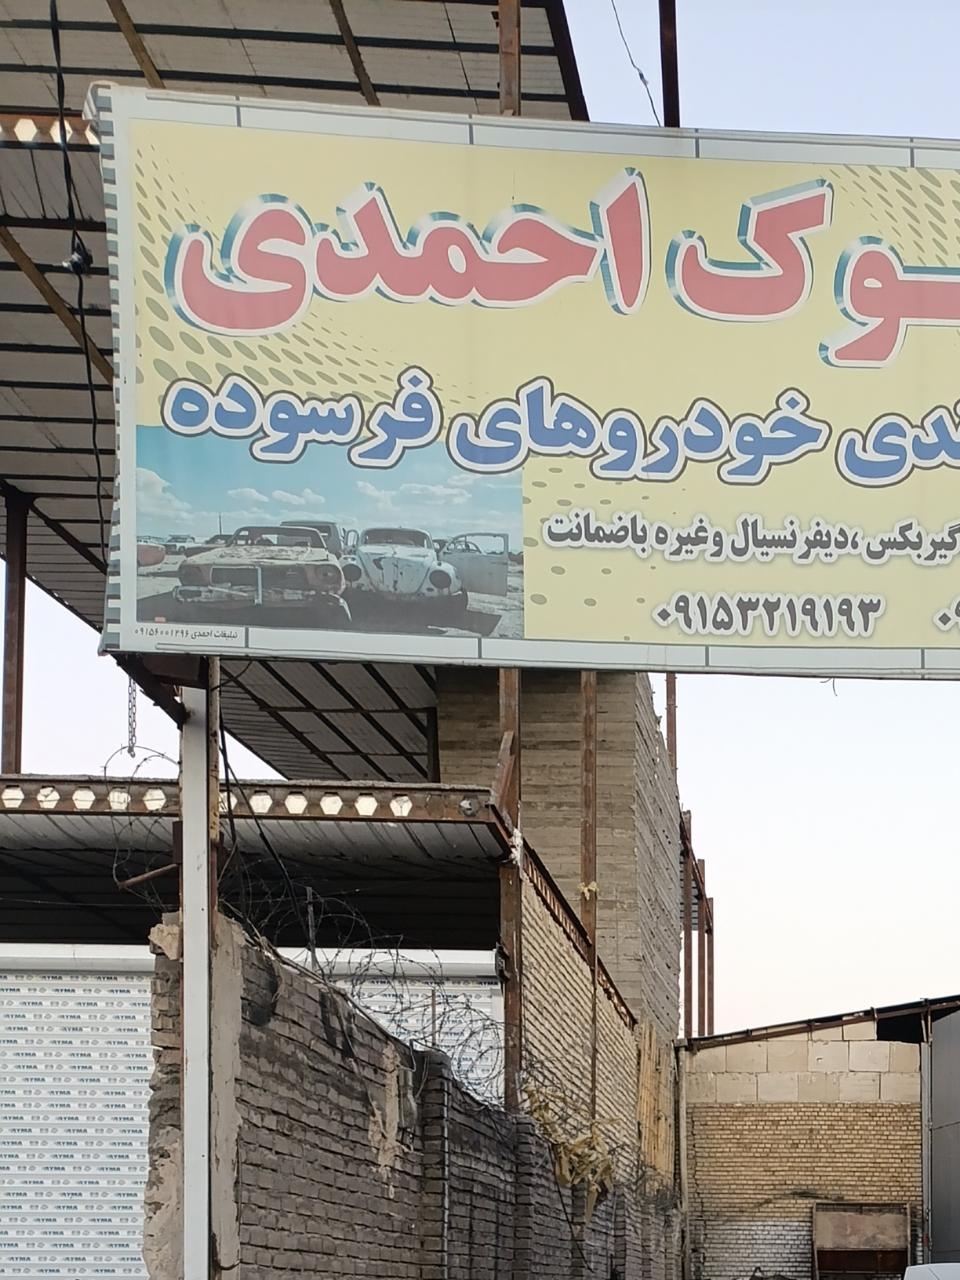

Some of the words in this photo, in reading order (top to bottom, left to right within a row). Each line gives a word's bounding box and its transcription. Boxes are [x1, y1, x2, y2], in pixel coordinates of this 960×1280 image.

[166, 168, 651, 336] احمدی
[166, 371, 439, 462] فرسوده
[452, 382, 826, 479] خودروهای
[547, 511, 648, 554] باضمانت
[190, 629, 213, 640] احمدی
[656, 593, 882, 633] ۰۹۱۵۳۲۱۹۱۹۳
